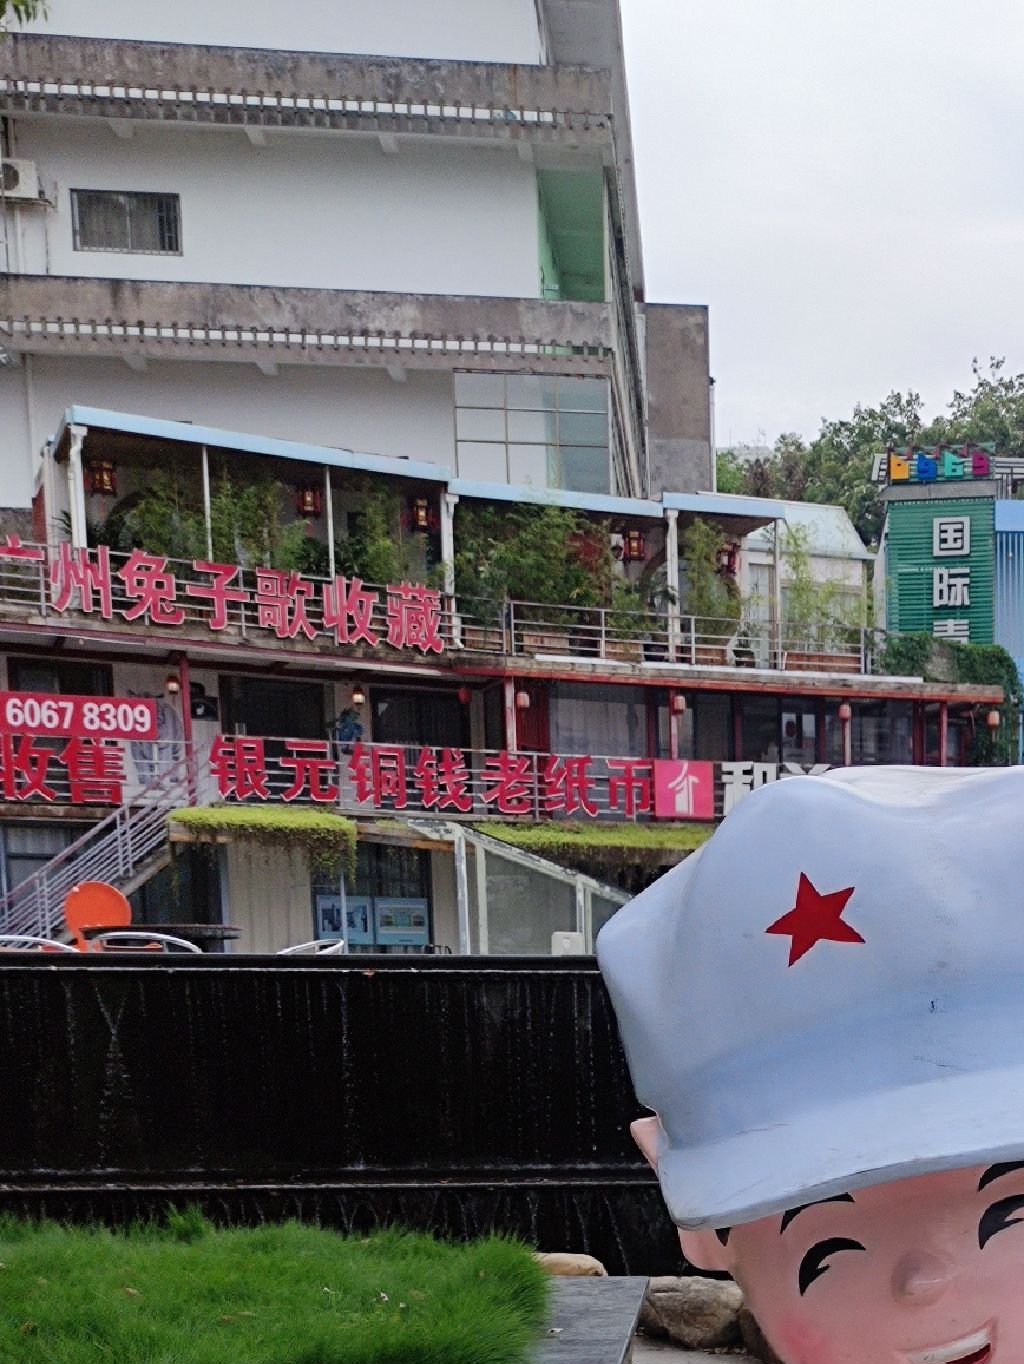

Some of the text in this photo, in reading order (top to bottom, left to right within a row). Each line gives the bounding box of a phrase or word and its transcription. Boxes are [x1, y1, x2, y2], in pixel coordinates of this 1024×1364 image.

[5, 698, 151, 733] 6067 8309
[209, 735, 657, 817] 银元铜钱老纸币
